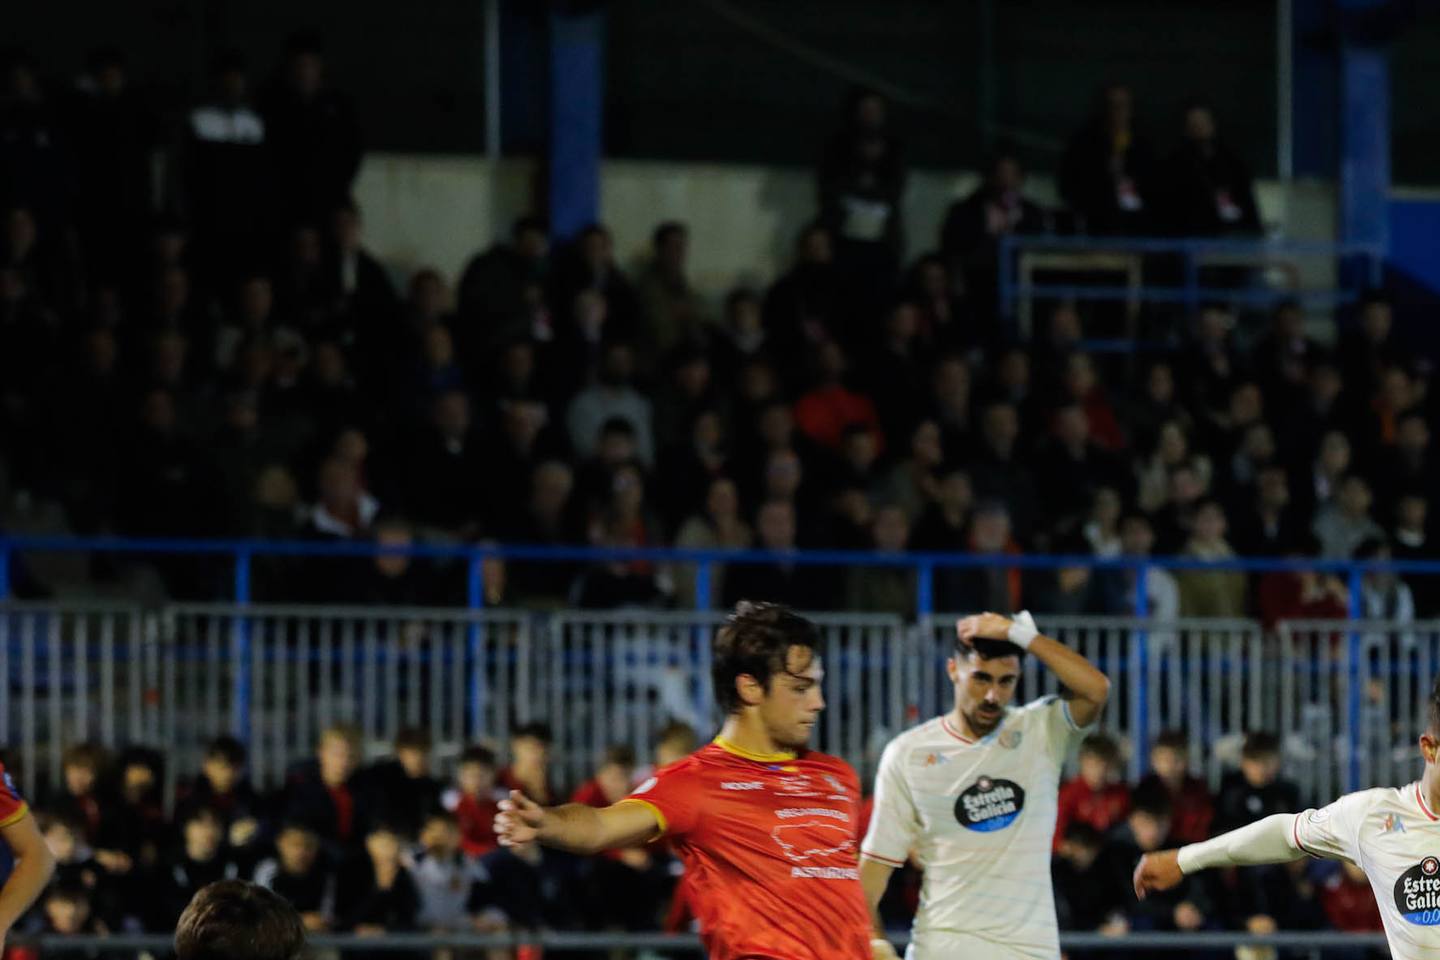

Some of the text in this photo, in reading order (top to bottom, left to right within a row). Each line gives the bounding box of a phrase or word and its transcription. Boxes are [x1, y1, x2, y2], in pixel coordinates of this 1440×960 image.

[963, 787, 1015, 809] Estrella
[968, 801, 1017, 822] Galicia
[1422, 908, 1440, 924] 0,0
